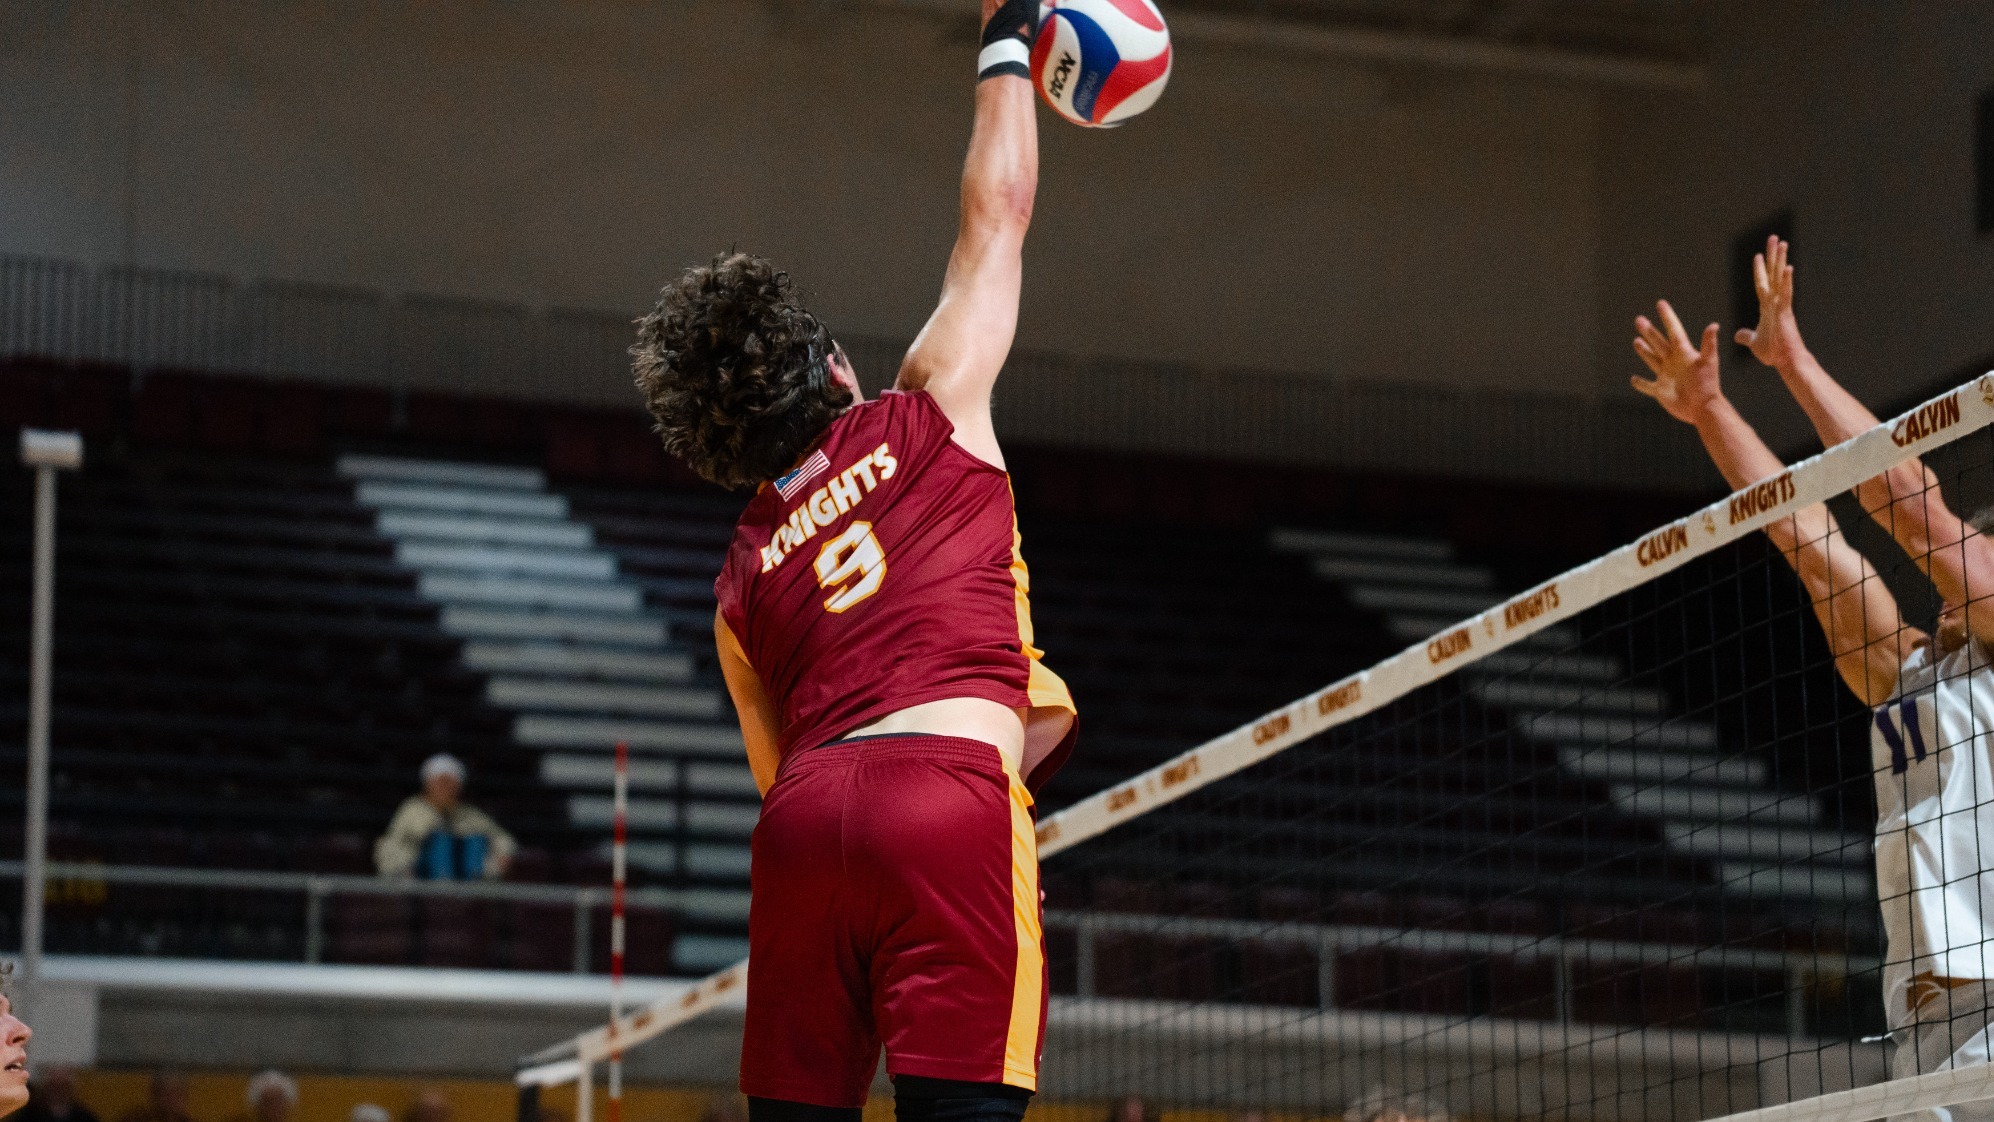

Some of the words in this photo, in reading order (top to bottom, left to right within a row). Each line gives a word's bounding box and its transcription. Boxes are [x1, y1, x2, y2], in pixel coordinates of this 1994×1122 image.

[1049, 51, 1076, 99] NCAA
[1891, 391, 1960, 448] CALVIN
[760, 442, 898, 574] KNIGHTS
[1729, 471, 1796, 526] KNIGHTS
[813, 520, 888, 614] 9
[1875, 696, 1927, 776] 11
